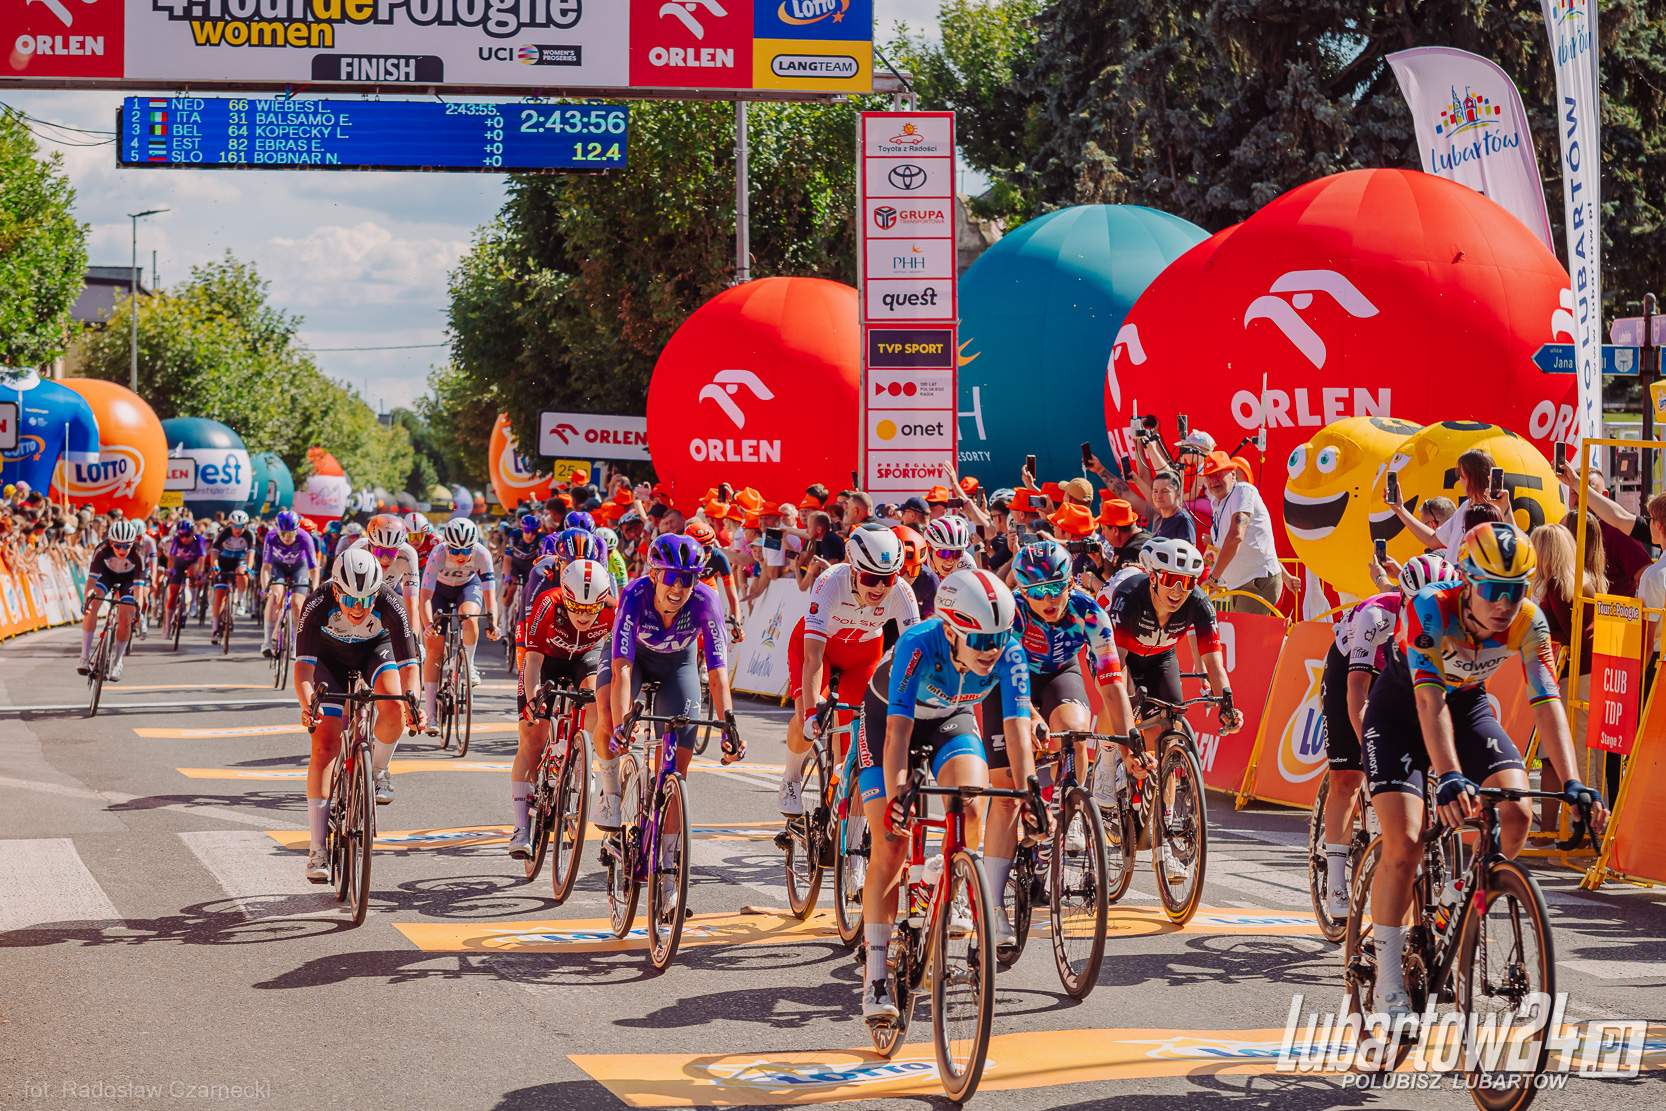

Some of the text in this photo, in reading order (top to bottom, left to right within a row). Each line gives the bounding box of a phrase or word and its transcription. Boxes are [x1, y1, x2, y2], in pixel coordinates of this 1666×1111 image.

[190, 19, 334, 48] women
[15, 34, 104, 56] ORLEN
[478, 46, 513, 61] UCI
[648, 46, 734, 68] ORLEN
[778, 61, 853, 72] LANGTEAM
[340, 57, 416, 81] FINISH
[132, 99, 139, 109] 1
[171, 100, 205, 110] NED
[228, 100, 249, 111] 66
[256, 100, 315, 112] WIEBES
[317, 101, 331, 113] L.
[131, 112, 504, 128] 2 ITA 31 BALSAMO E. +0
[520, 109, 626, 134] 2:43:56
[131, 125, 504, 141] 3 BEL 64 KOPECKY L. +0
[131, 138, 504, 155] 4 EST 82 EBRAS E. +0
[571, 142, 622, 161] 12.4
[878, 145, 901, 153] Toyota
[1430, 129, 1519, 173] Lubartów
[130, 151, 502, 167] 5 SLO 161 BOBNAR N. +0
[899, 210, 945, 220] GRUPA
[1564, 96, 1590, 347] LUBARTÓW
[893, 256, 925, 269] PHH
[882, 287, 938, 311] quest
[877, 343, 944, 354] TVP SPORT
[1553, 355, 1574, 369] Jana
[1231, 387, 1392, 430] ORLEN
[583, 428, 647, 448] ORLEN
[901, 422, 944, 437] onet
[689, 438, 781, 463] ORLEN
[75, 458, 127, 483] LOTTO
[877, 468, 944, 479] SPORTOWY
[619, 613, 634, 656] Jayco
[707, 619, 726, 661] Jayco
[1452, 655, 1509, 673] sdwor
[1603, 667, 1628, 694] CLUB
[1604, 700, 1623, 726] TDP
[1600, 732, 1622, 748] Stage 2
[1366, 739, 1379, 777] sdworx
